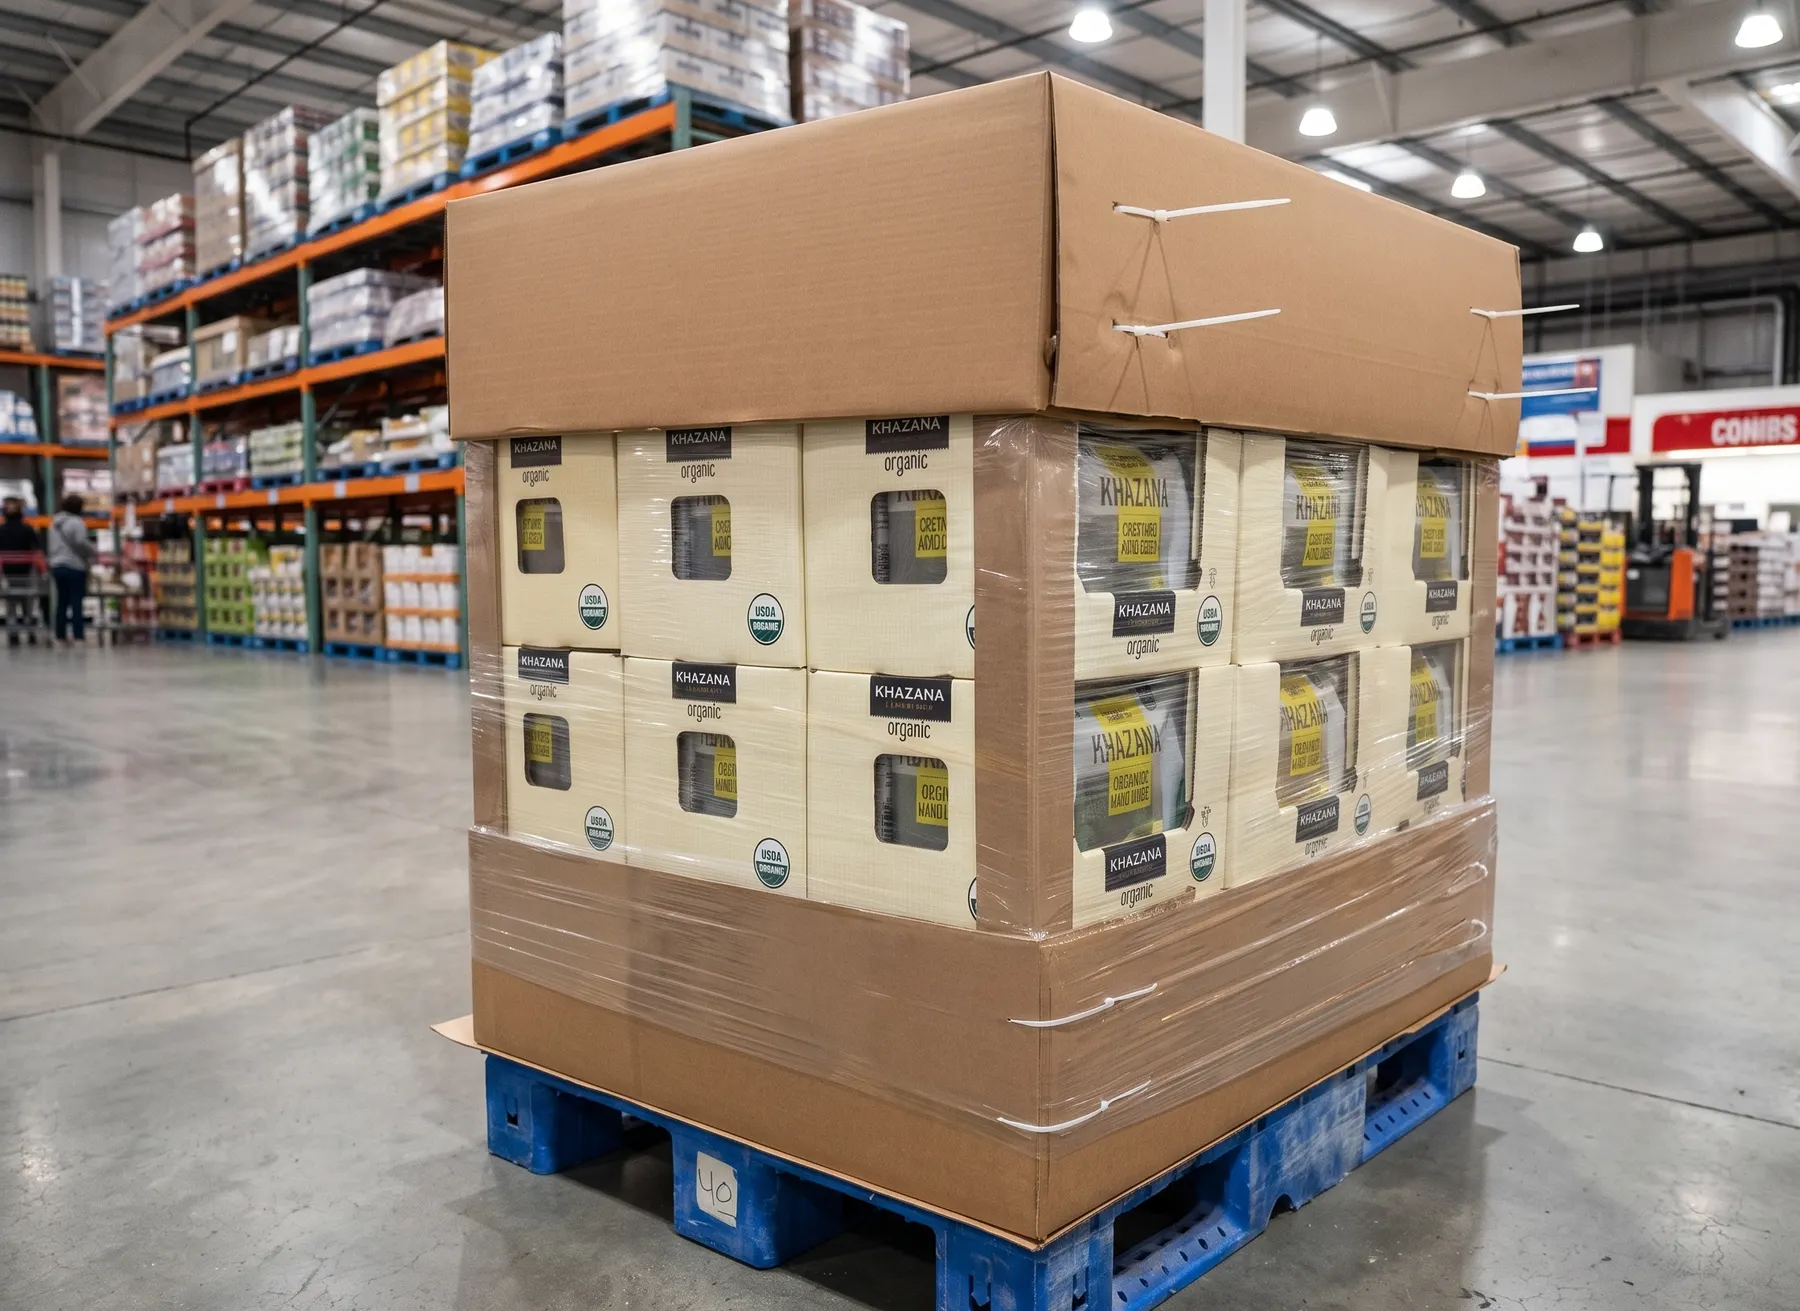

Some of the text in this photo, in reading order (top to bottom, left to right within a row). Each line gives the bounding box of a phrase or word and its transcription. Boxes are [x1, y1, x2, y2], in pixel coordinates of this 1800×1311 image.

[872, 417, 941, 435] KHAZANA
[514, 439, 558, 454] KHAZANA
[671, 430, 727, 446] KHAZANA
[681, 462, 716, 483] organic
[884, 451, 928, 477] organic
[522, 467, 551, 488] organic
[1100, 476, 1169, 508] KHAZANA
[584, 595, 602, 605] USDA
[1304, 598, 1342, 612] KHAZANA
[755, 605, 776, 618] USDA
[1118, 602, 1171, 618] KHAZANA
[1126, 635, 1160, 660] organic
[521, 655, 565, 669] KHAZANA
[676, 671, 731, 687] KHAZANA
[529, 682, 558, 701] organic
[875, 685, 945, 702] KHAZANA
[687, 701, 722, 723] organic
[887, 720, 931, 742] organic
[1091, 724, 1162, 764] KHAZANA
[590, 816, 608, 828] USDA
[1299, 805, 1338, 827] KHAZANA
[760, 849, 783, 862] USDA
[1109, 847, 1162, 872] KHAZANA
[1120, 882, 1154, 908] organic
[698, 1168, 733, 1207] 40
